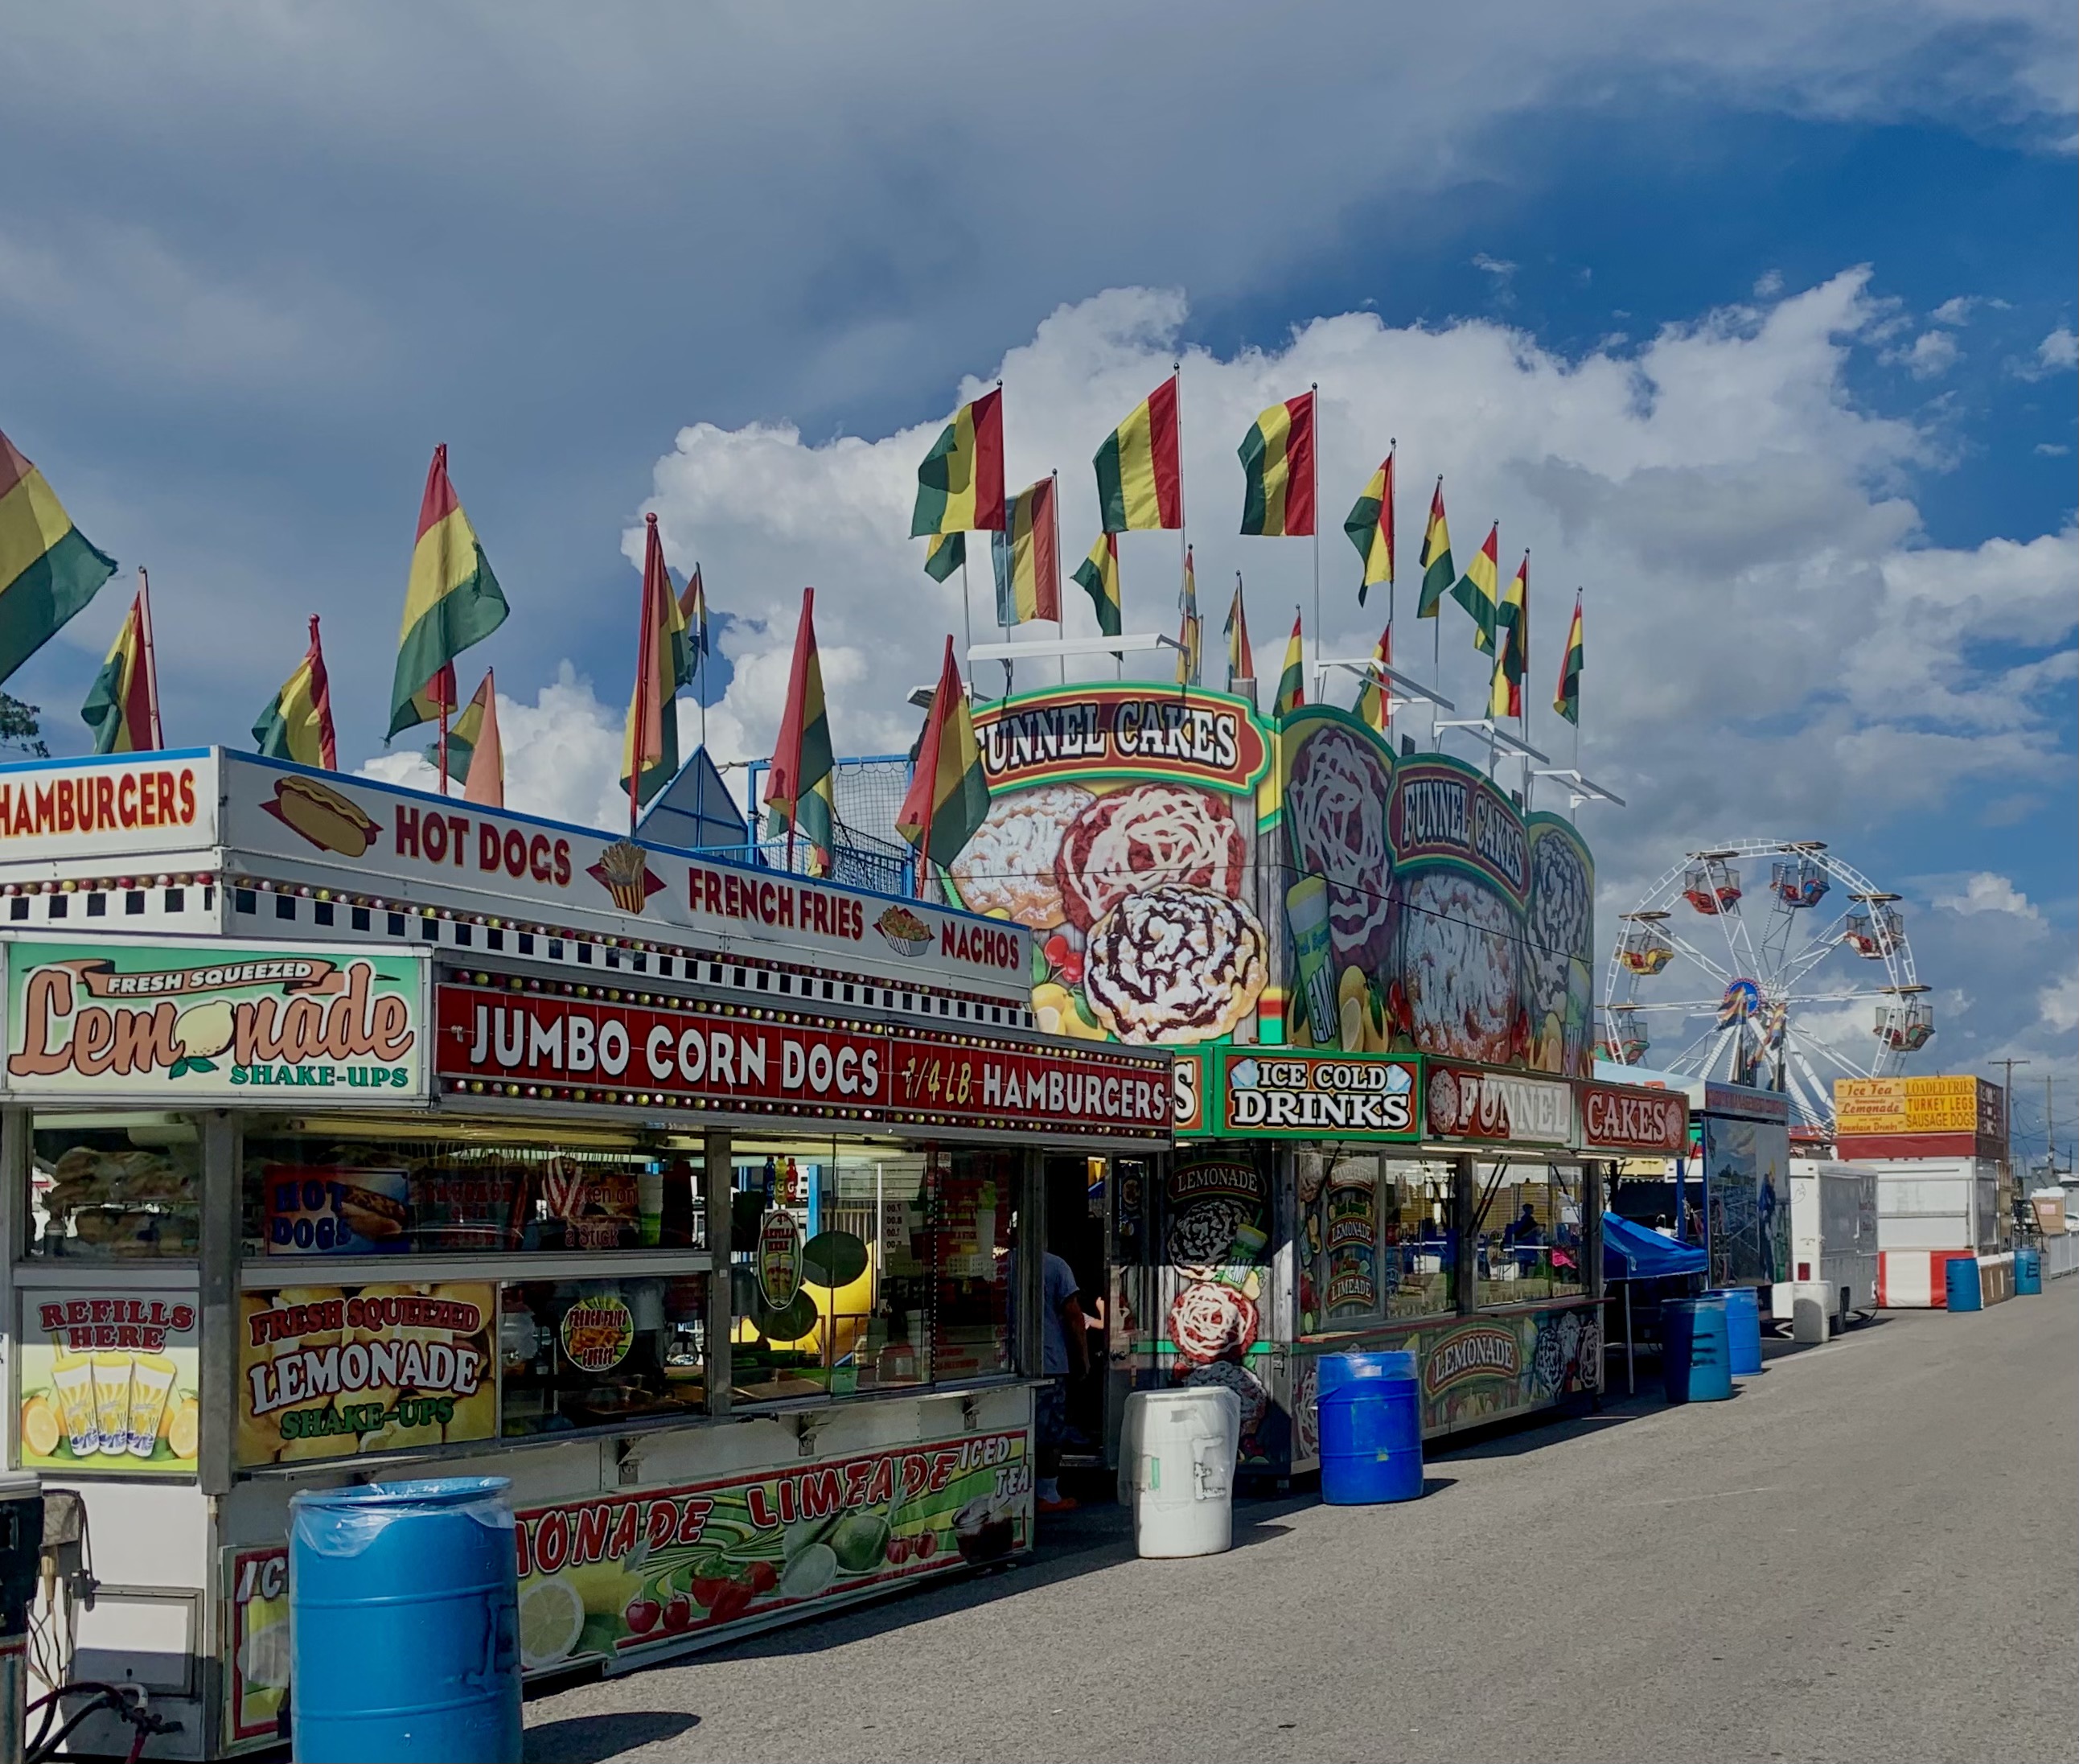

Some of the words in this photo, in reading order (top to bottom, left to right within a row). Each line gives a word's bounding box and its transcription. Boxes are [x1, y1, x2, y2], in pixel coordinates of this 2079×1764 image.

[1117, 701, 1237, 767] CAKES
[0, 767, 195, 837] HAMBURGERS
[396, 804, 470, 866] HOT
[479, 822, 571, 887] DOGS
[1403, 782, 1471, 842] FUNNEL
[1475, 795, 1522, 886] CAKES
[688, 867, 795, 931] FRENCH
[799, 890, 864, 941] FRIES
[941, 918, 1020, 971] NACHOS
[107, 971, 183, 994] FRESH
[189, 961, 313, 988] SQUEEZED
[470, 1005, 630, 1076] JUMBO
[646, 1025, 766, 1087] CORN
[783, 1039, 879, 1096] DOGS
[229, 1064, 409, 1088] SHAKE-UPS
[983, 1063, 1165, 1120] HAMBURGERS
[1260, 1063, 1307, 1088] ICE
[1316, 1064, 1387, 1089] COLD
[1847, 1084, 1866, 1096] Ice
[1871, 1083, 1892, 1095] Tea
[1905, 1081, 1945, 1094] LOADED
[1947, 1080, 1975, 1093] FRIES
[1235, 1092, 1408, 1127] DRINKS
[1458, 1076, 1568, 1132] FUNNEL
[1588, 1092, 1666, 1141] CAKES
[1841, 1102, 1900, 1114] Lemonade
[1906, 1112, 1948, 1128] SAUSAGE
[1950, 1112, 1976, 1126] DOGS
[1907, 1097, 1945, 1112] TURKEY
[1950, 1096, 1974, 1110] LEGS
[275, 1179, 349, 1212] HOT
[616, 1186, 638, 1204] on
[1177, 1166, 1259, 1194] LEMONADE
[271, 1217, 351, 1250] DOGS
[578, 1224, 619, 1247] Stick
[1331, 1220, 1372, 1243] LEMONADE
[1331, 1280, 1372, 1301] LIMEADE
[39, 1299, 195, 1330] REFILLS
[249, 1298, 344, 1347] FRESH
[347, 1297, 480, 1332] SQUEEZED
[68, 1327, 164, 1351] HERE
[1434, 1334, 1514, 1384] LEMONADE
[250, 1342, 479, 1416] LEMONADE
[281, 1397, 454, 1440] SHAKE-UPS
[959, 1436, 1011, 1470] ICED
[746, 1453, 958, 1528] LIMEADE
[995, 1465, 1033, 1498] TEA
